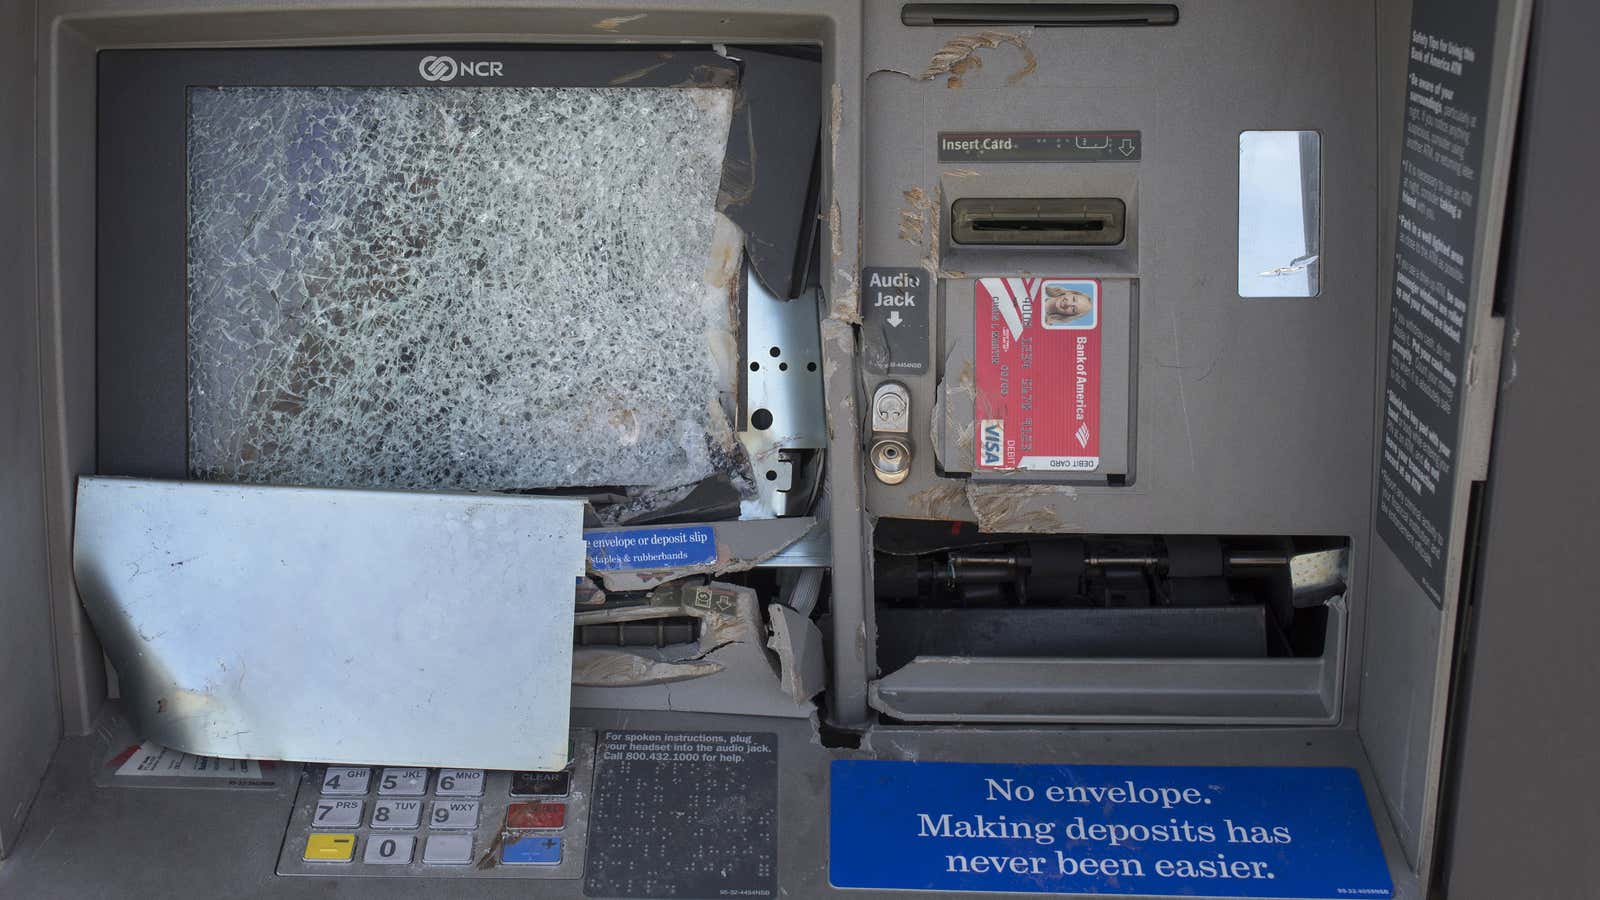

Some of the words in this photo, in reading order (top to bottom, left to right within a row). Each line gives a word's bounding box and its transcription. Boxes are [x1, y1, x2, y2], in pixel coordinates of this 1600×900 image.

[1411, 47, 1423, 61] Bank
[1430, 54, 1450, 71] America
[460, 61, 504, 76] NCR
[943, 138, 980, 151] Insert
[983, 138, 1012, 151] Card
[869, 273, 920, 288] Audio
[874, 291, 916, 307] Jack
[1076, 336, 1088, 363] Bank
[1076, 376, 1088, 420] America
[985, 424, 1000, 464] VISA
[1007, 440, 1016, 465] DEBIT
[1050, 459, 1071, 468] CARD
[1073, 459, 1094, 468] DEBIT
[593, 536, 636, 549] envelope
[638, 537, 649, 545] or
[650, 532, 687, 546] deposit
[689, 531, 708, 544] slip
[591, 553, 622, 564] staples
[623, 554, 631, 562] &
[633, 551, 688, 562] rubberbands
[606, 732, 623, 741] For
[624, 733, 661, 743] spoken
[664, 734, 728, 744] instructions,
[729, 734, 752, 744] plug
[605, 743, 627, 752] your
[629, 742, 671, 751] headset
[673, 743, 693, 752] into
[696, 743, 713, 752] the
[715, 744, 745, 752] audio
[746, 744, 772, 754] jack.
[603, 752, 623, 761] Call
[625, 752, 699, 762] 800.432.1000
[702, 753, 717, 762] for
[719, 754, 745, 763] help.
[325, 774, 340, 790] 4
[382, 775, 398, 790] 5
[440, 776, 455, 790] 6
[984, 778, 1035, 801] No
[1046, 781, 1212, 809] envelope.
[319, 805, 333, 821] 7
[375, 807, 390, 822] 8
[434, 807, 449, 823] 9
[451, 804, 474, 812] WXY
[917, 813, 1056, 844] Making
[1065, 816, 1216, 845] deposits
[1223, 819, 1292, 844] has
[379, 839, 396, 857] 0
[946, 854, 1046, 874] never
[1055, 850, 1145, 877] been
[1155, 853, 1275, 880] easier.
